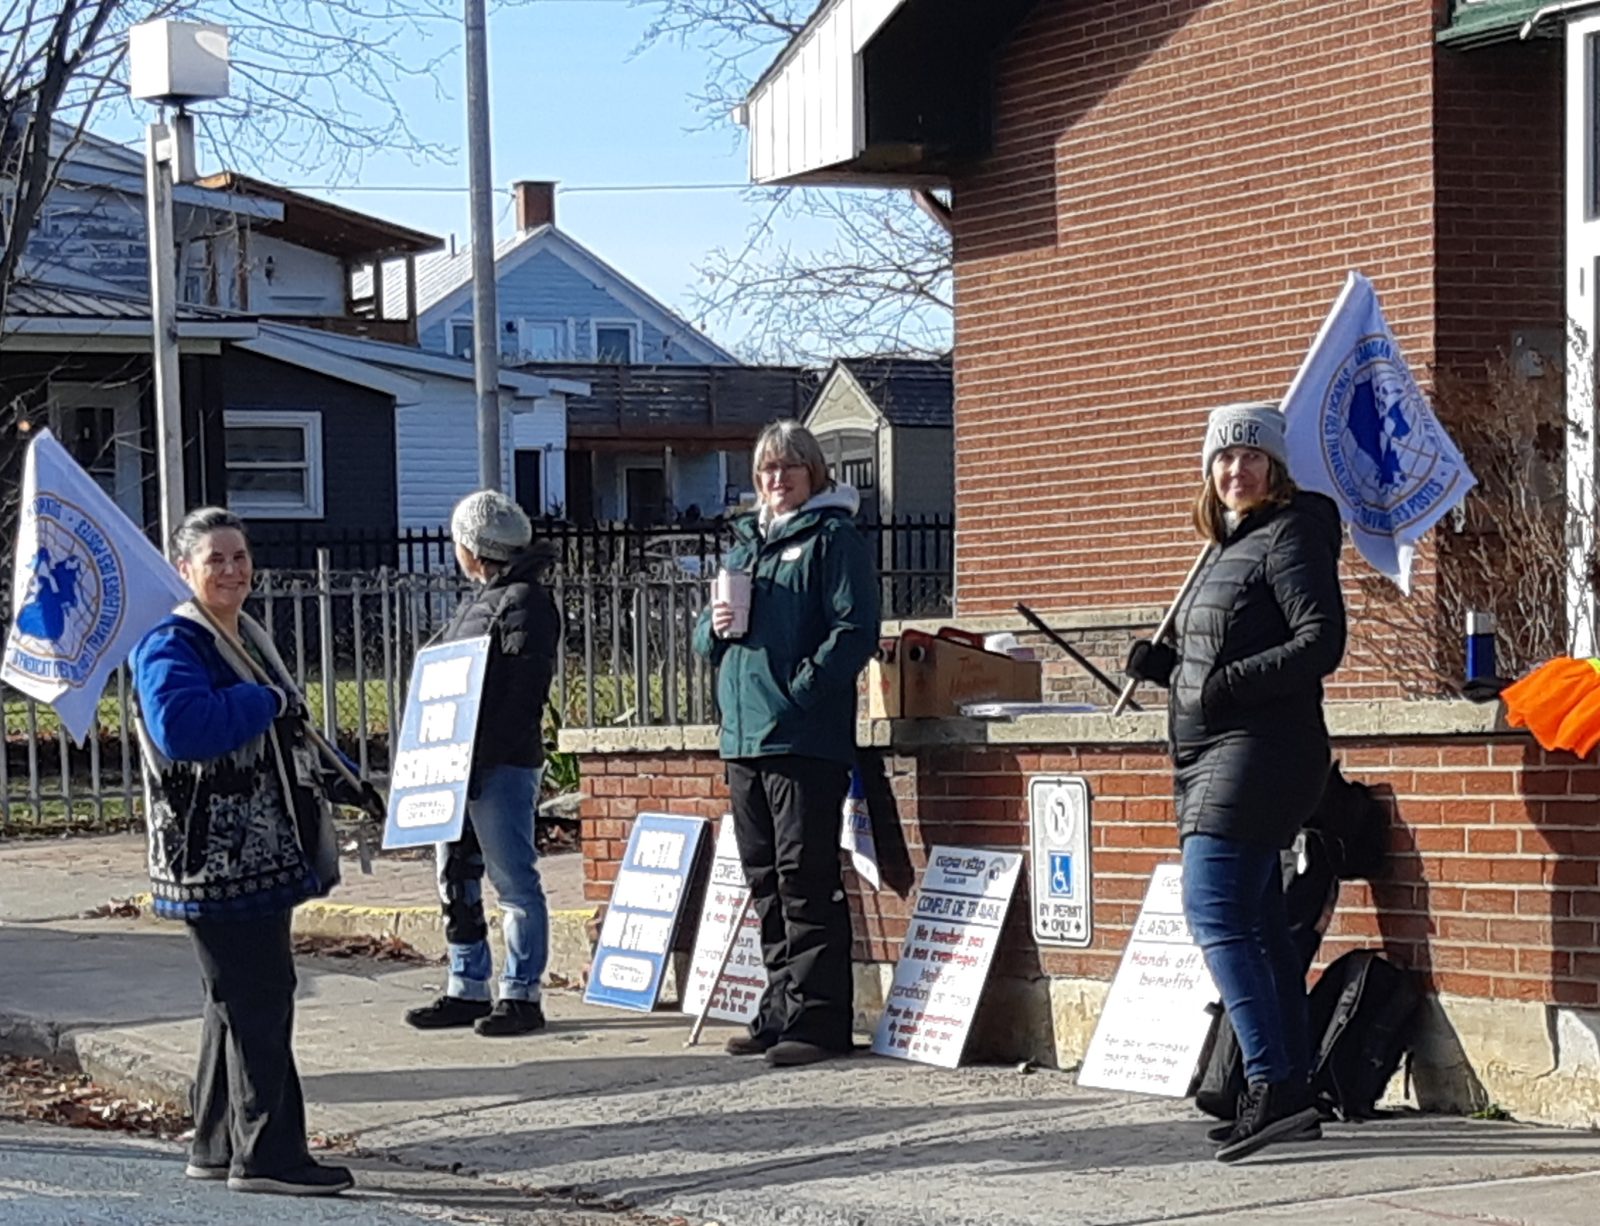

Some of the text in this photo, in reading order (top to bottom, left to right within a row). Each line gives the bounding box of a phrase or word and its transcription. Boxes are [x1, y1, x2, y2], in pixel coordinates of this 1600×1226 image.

[1218, 422, 1260, 446] VGK
[1040, 903, 1082, 919] BY PERMIT
[1051, 919, 1071, 933] ONLY
[1131, 950, 1169, 968] Hands
